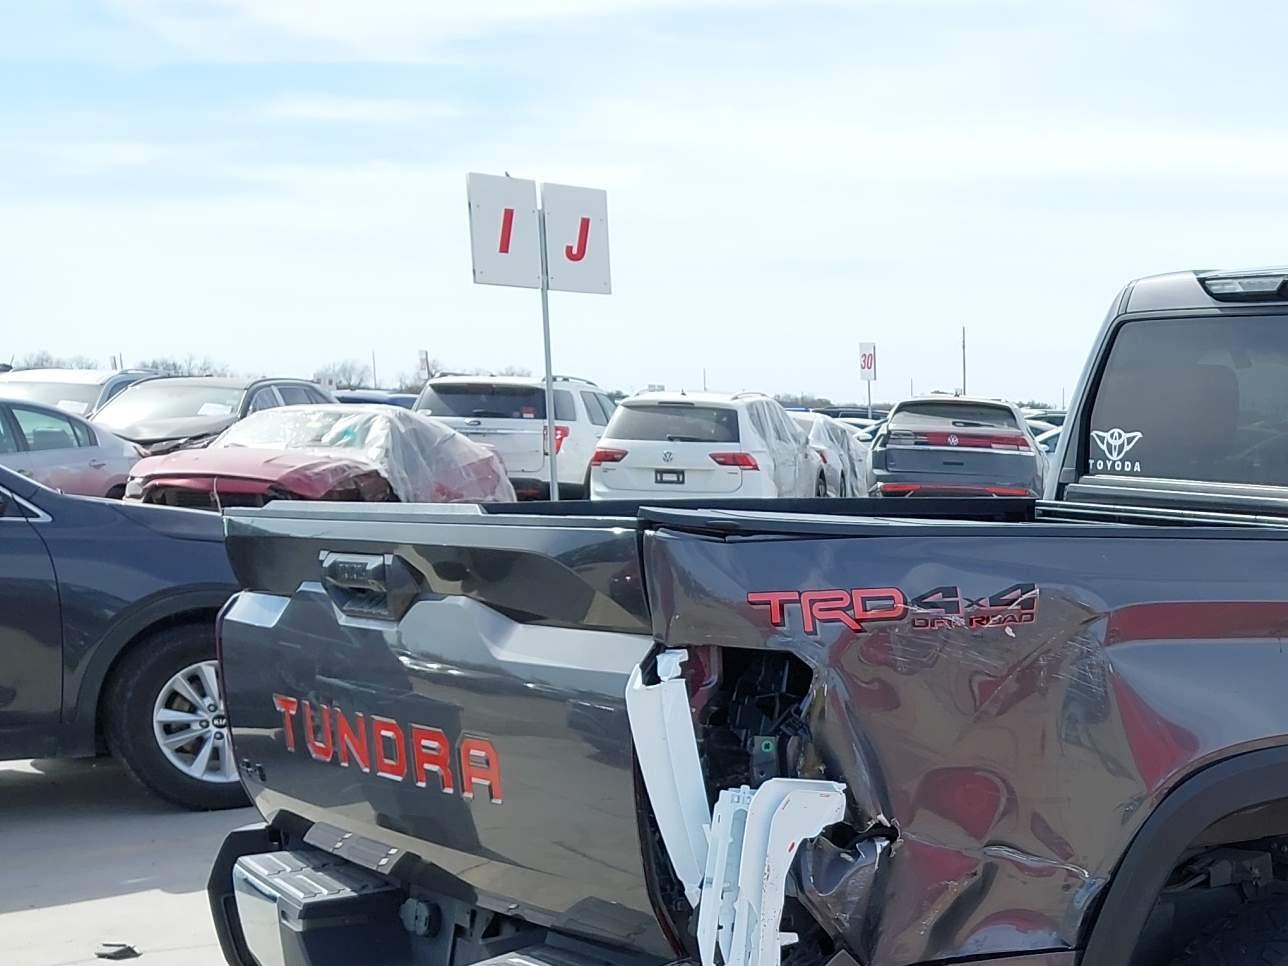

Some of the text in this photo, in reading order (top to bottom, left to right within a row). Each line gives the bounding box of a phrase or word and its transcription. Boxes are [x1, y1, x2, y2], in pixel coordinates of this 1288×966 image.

[498, 208, 514, 254] I
[565, 216, 591, 262] J
[860, 352, 873, 370] 30
[1089, 459, 1141, 472] TOYODA
[747, 586, 907, 635] TRD
[272, 692, 503, 804] TUNDRA
